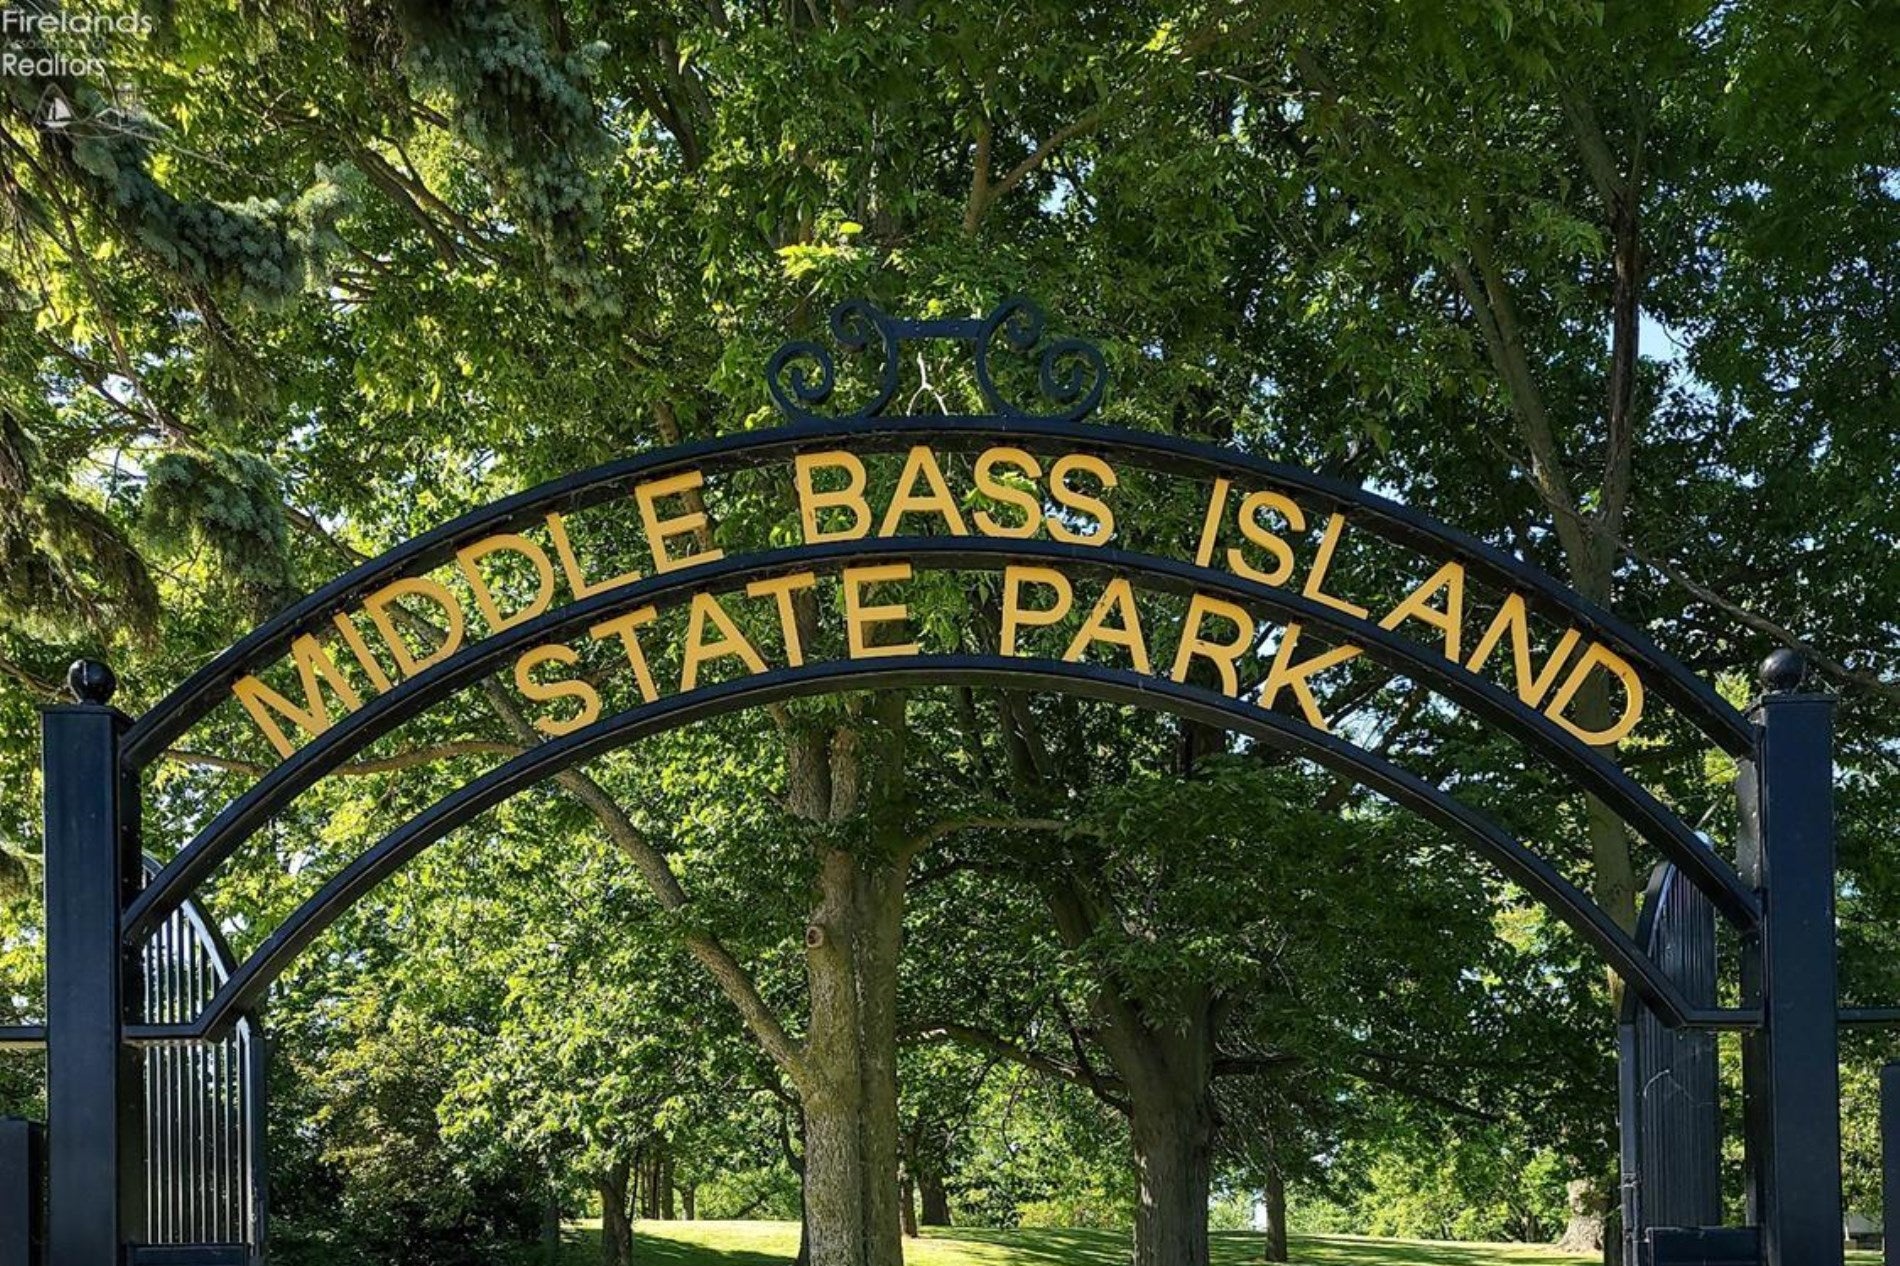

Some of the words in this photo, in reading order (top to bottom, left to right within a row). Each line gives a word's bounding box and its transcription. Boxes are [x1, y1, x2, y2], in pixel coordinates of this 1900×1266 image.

[231, 470, 725, 760] MIDDLE
[795, 445, 1119, 547] BASS
[1195, 477, 1644, 746] ISLAND
[515, 563, 920, 737] STATE
[1000, 566, 1364, 733] PARK
